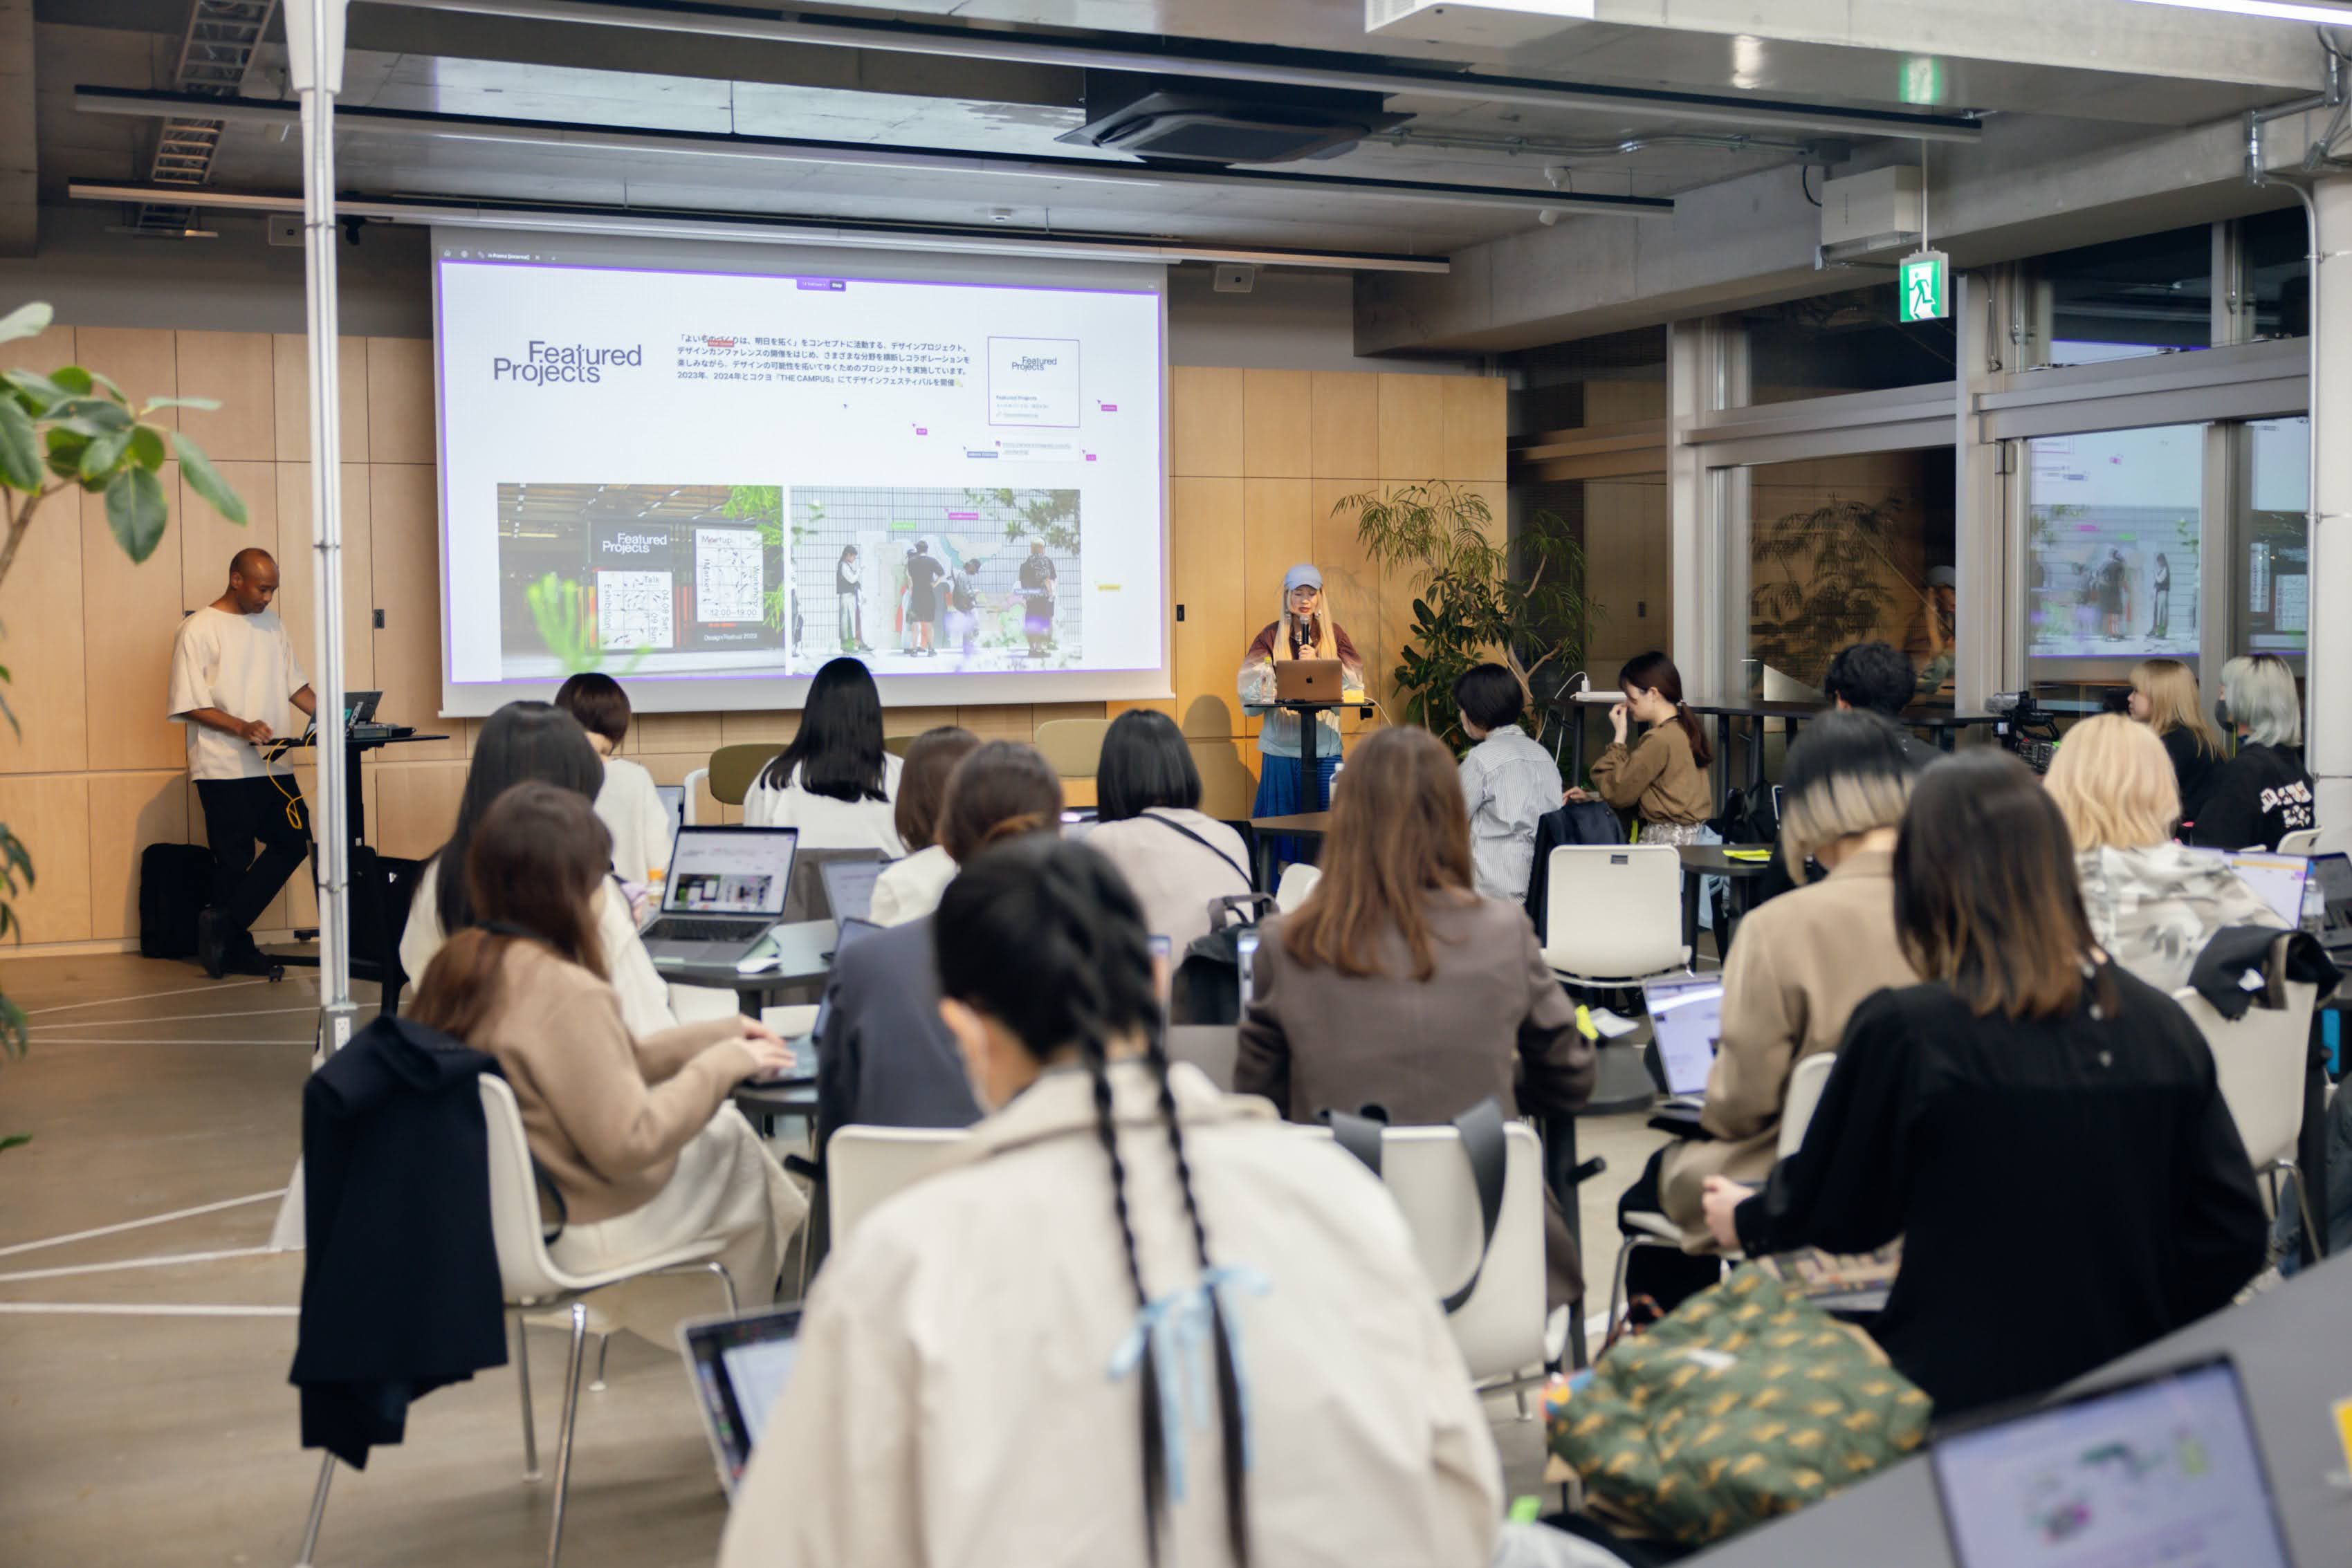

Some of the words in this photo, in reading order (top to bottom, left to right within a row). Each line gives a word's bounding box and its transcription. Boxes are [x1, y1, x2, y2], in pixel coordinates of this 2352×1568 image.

[529, 340, 642, 366] Featured
[1011, 362, 1045, 371] Projects
[1022, 356, 1057, 365] Featured
[493, 358, 600, 387] Projects
[617, 533, 667, 545] Featured
[603, 540, 650, 555] Projects
